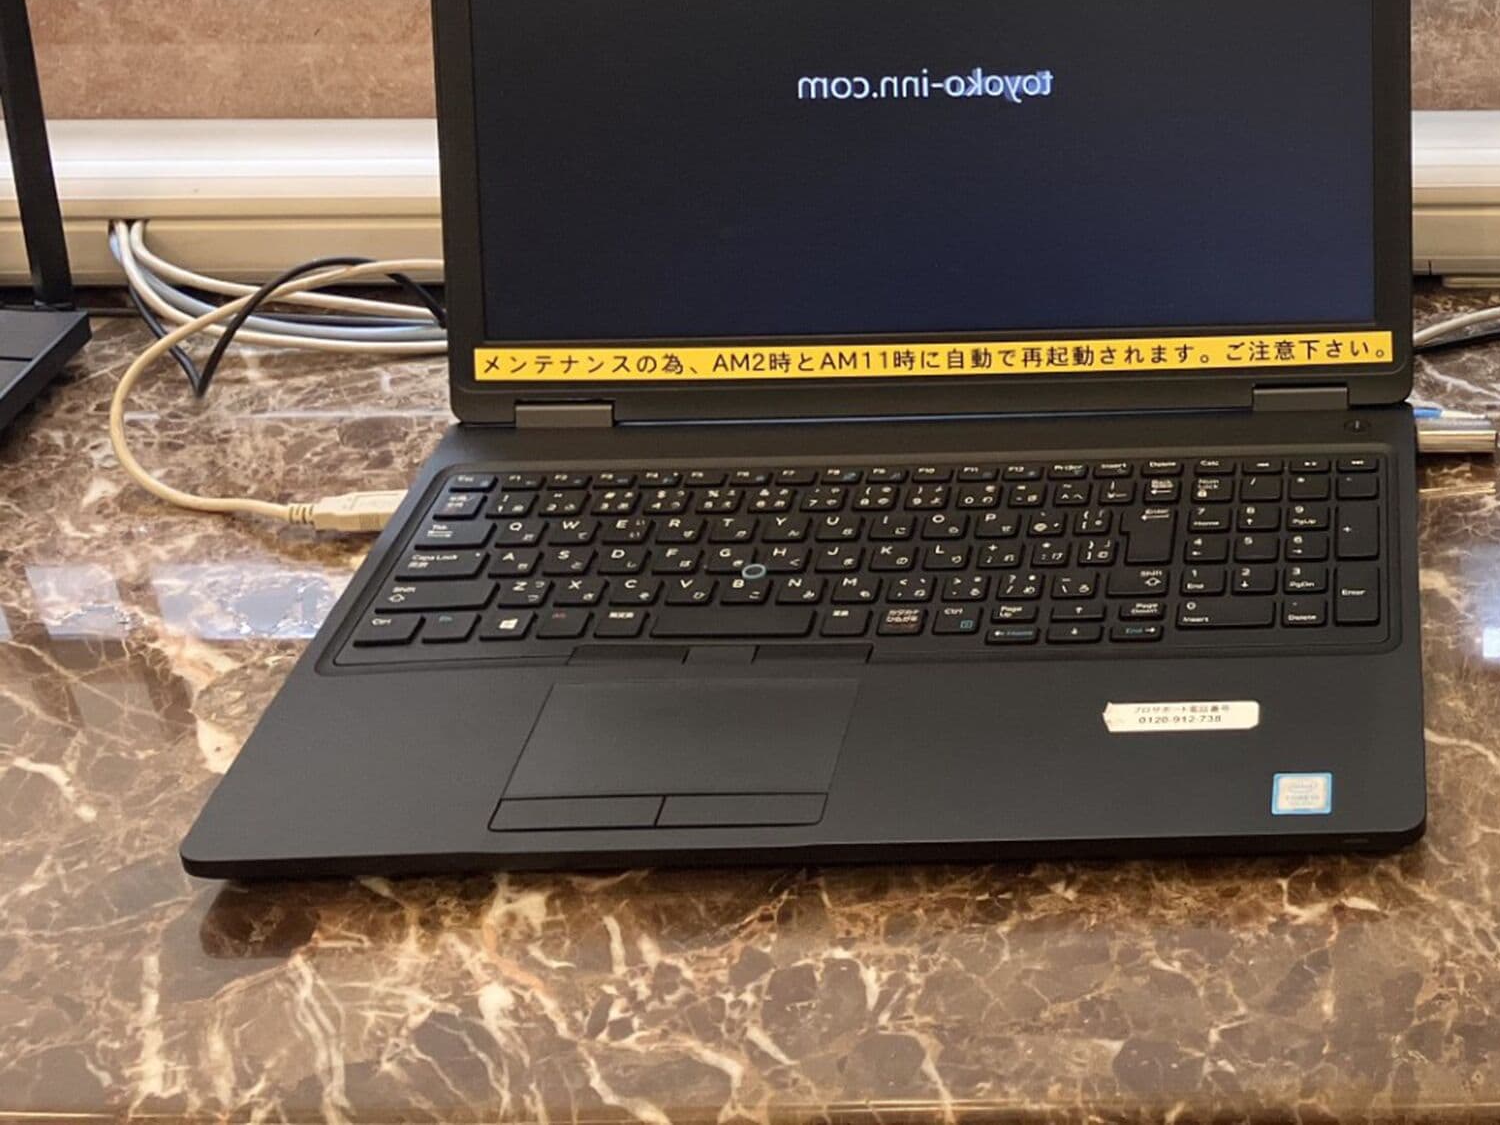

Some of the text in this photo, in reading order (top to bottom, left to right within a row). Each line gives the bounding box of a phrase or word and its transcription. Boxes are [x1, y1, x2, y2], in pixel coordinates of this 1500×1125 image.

[482, 338, 1386, 375] メンテナンスの為、AM2時とAM11時に自動で再起動されます。ご注意下さい。
[668, 519, 681, 527] R
[723, 518, 735, 526] T
[776, 517, 787, 526] Y
[826, 517, 840, 525] U
[932, 515, 945, 523] O
[509, 522, 522, 531] Q
[562, 521, 580, 529] W
[616, 520, 629, 528] E
[665, 549, 679, 557] F
[720, 548, 731, 557] G
[773, 548, 787, 556] H
[827, 547, 839, 555] J
[880, 546, 893, 554] K
[935, 545, 945, 554] L
[558, 551, 571, 559] S
[611, 550, 625, 558] D
[568, 580, 582, 589] X
[624, 580, 638, 588] C
[679, 580, 693, 588] V
[732, 580, 744, 588] B
[788, 578, 802, 587] N
[842, 578, 857, 586] M
[512, 582, 528, 591] Z
